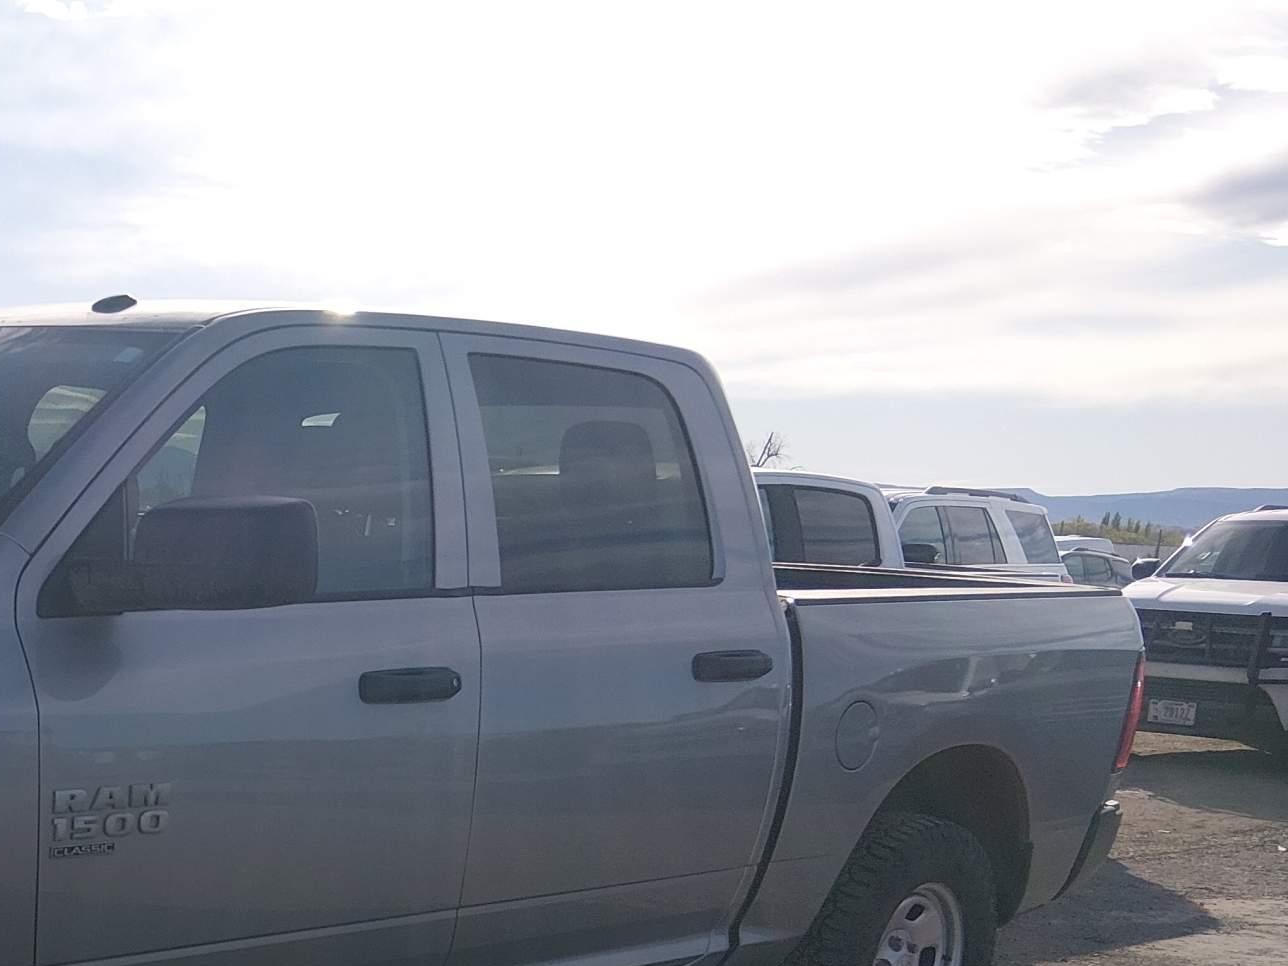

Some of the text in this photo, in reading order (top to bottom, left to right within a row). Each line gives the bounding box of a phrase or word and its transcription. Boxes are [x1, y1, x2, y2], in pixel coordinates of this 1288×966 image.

[52, 783, 171, 814] RAM
[52, 810, 169, 841] 1500
[48, 842, 115, 859] CLASSIC
